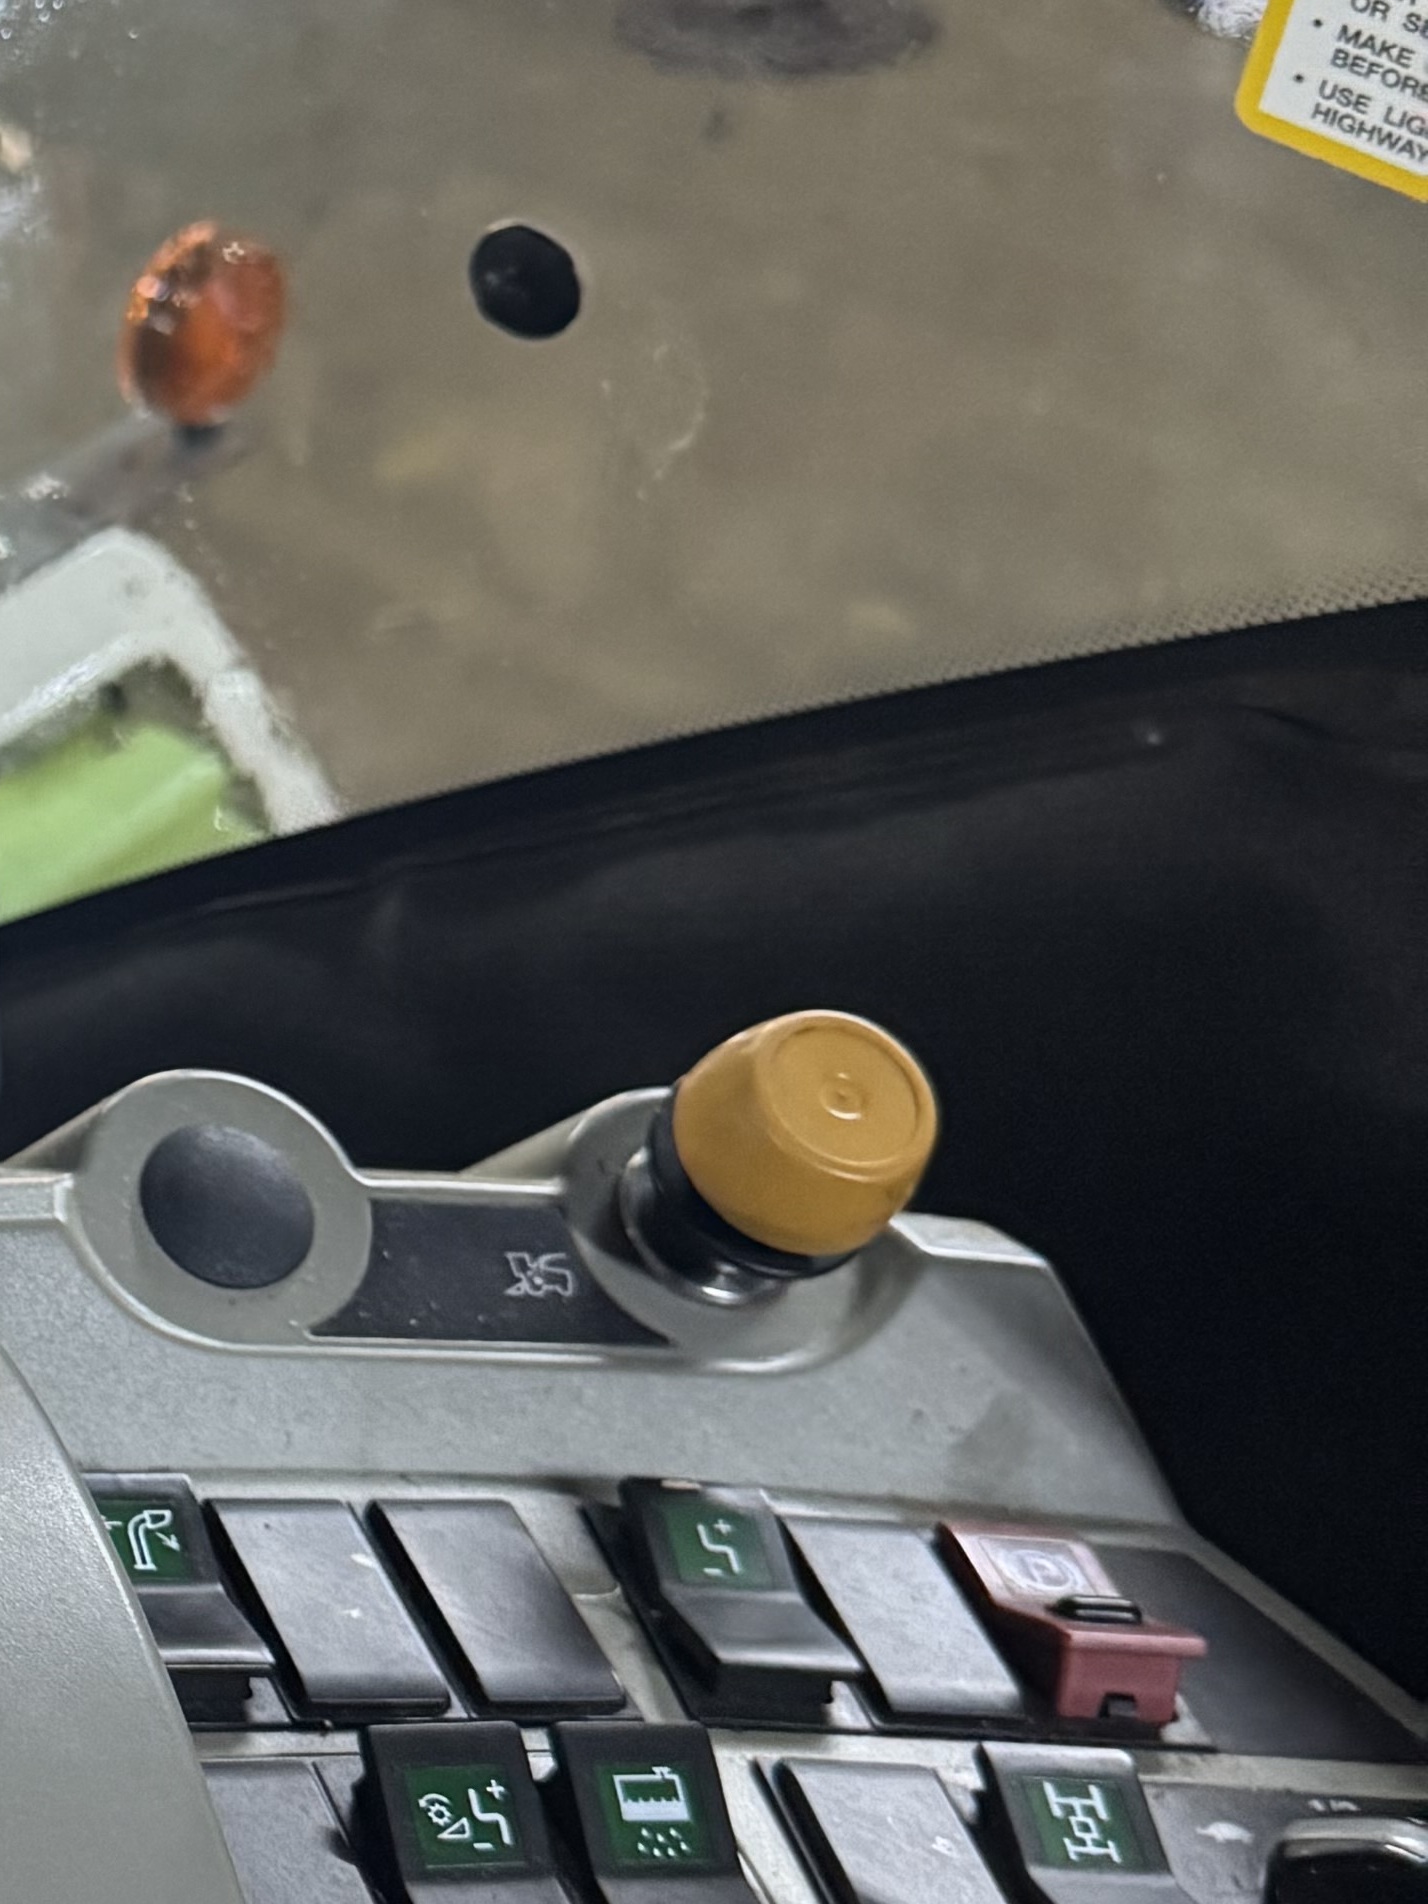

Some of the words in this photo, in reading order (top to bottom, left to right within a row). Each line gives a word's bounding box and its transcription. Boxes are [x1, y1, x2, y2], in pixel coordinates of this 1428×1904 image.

[1337, 24, 1417, 70] MAKE
[1318, 79, 1372, 115] USE
[1382, 105, 1428, 139] LIG
